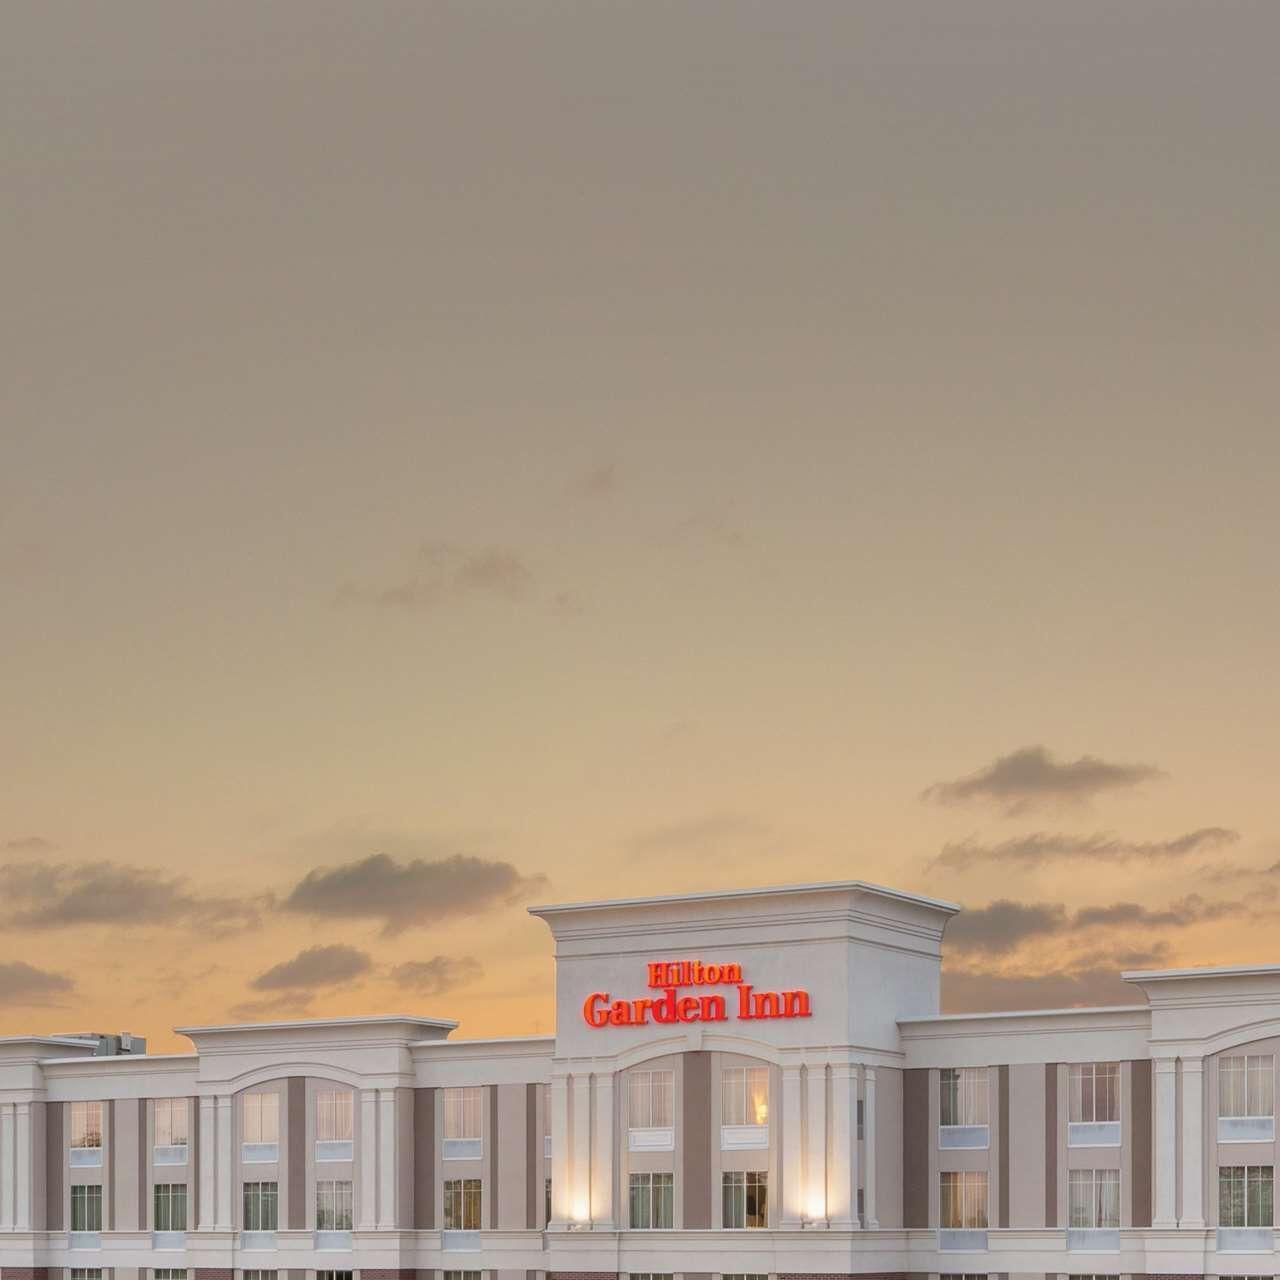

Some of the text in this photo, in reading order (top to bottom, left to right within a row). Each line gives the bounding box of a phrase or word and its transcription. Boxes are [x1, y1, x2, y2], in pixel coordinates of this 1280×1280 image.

[647, 959, 743, 988] Hilton
[583, 984, 812, 1028] Garden Inn
